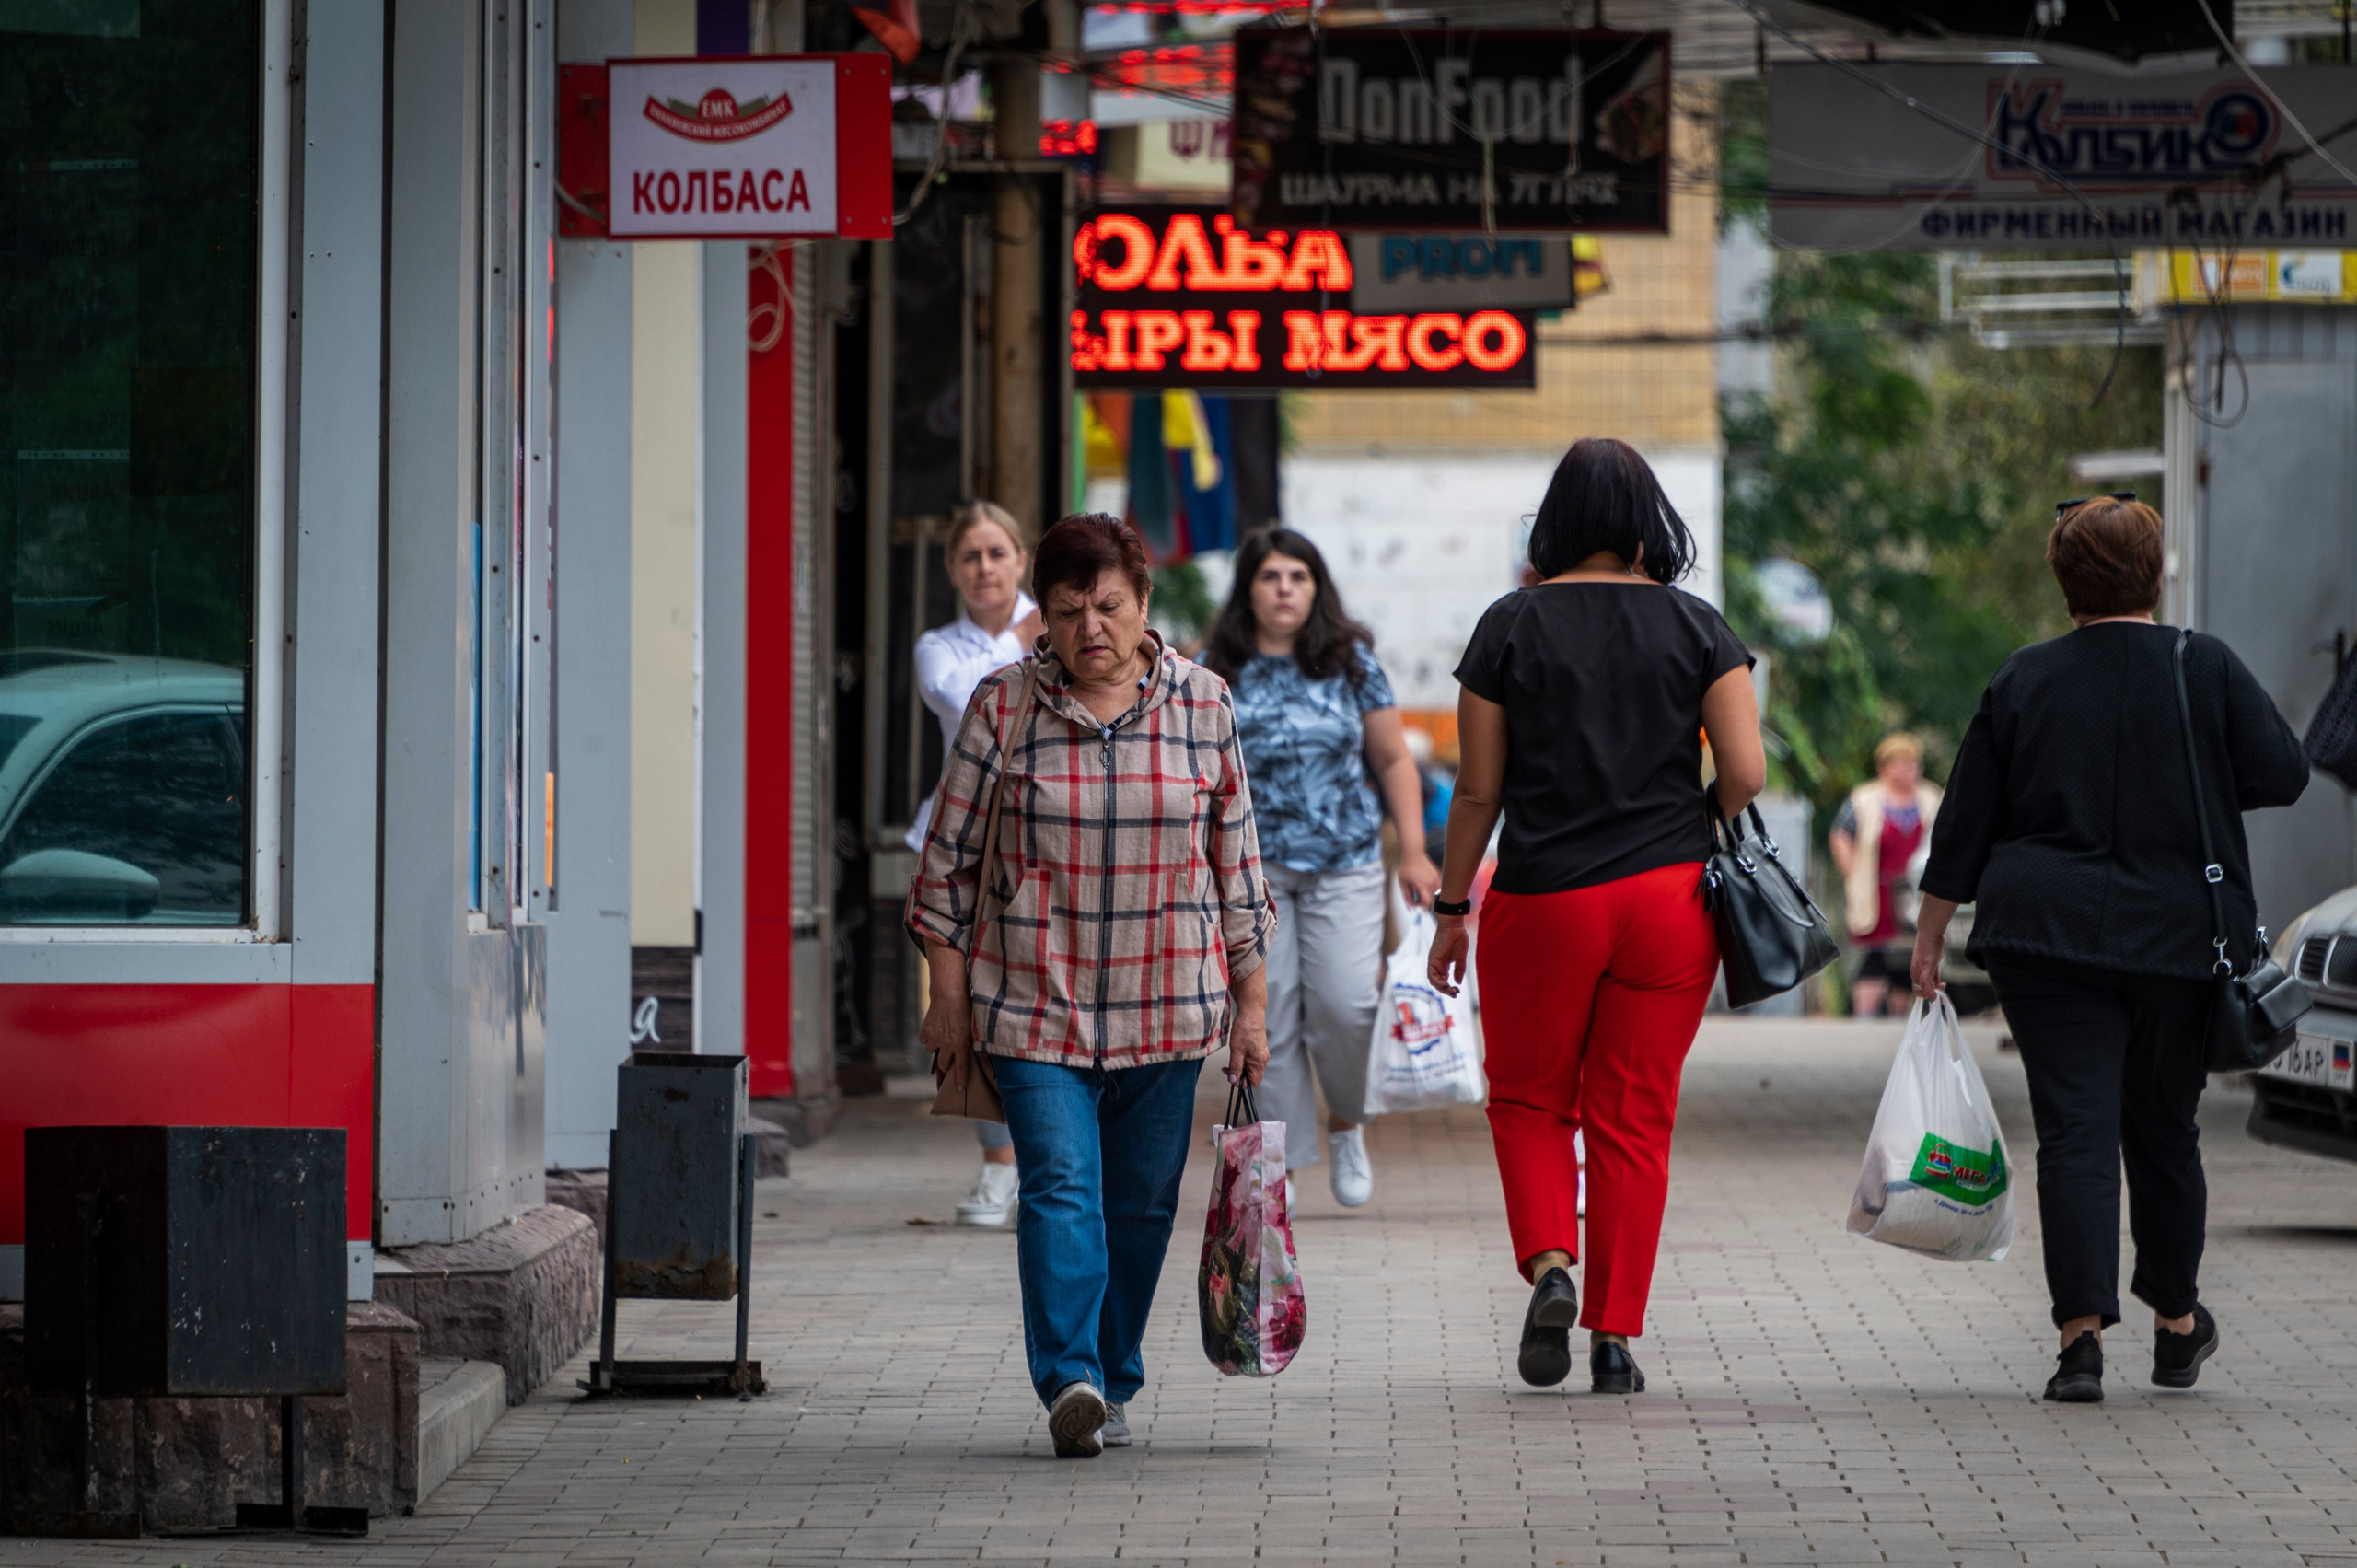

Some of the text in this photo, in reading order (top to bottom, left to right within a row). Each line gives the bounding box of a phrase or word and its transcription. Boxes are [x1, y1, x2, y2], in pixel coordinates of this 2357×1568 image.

[1318, 55, 1584, 145] DonFood
[633, 168, 811, 215] КОЛБАСА
[1281, 173, 1438, 206] ШАУРМА
[1447, 173, 1498, 206] НА
[1920, 201, 2348, 239] ФИРМЕННЫЙ МАГАЗИН
[1283, 309, 1527, 372] МЯСО
